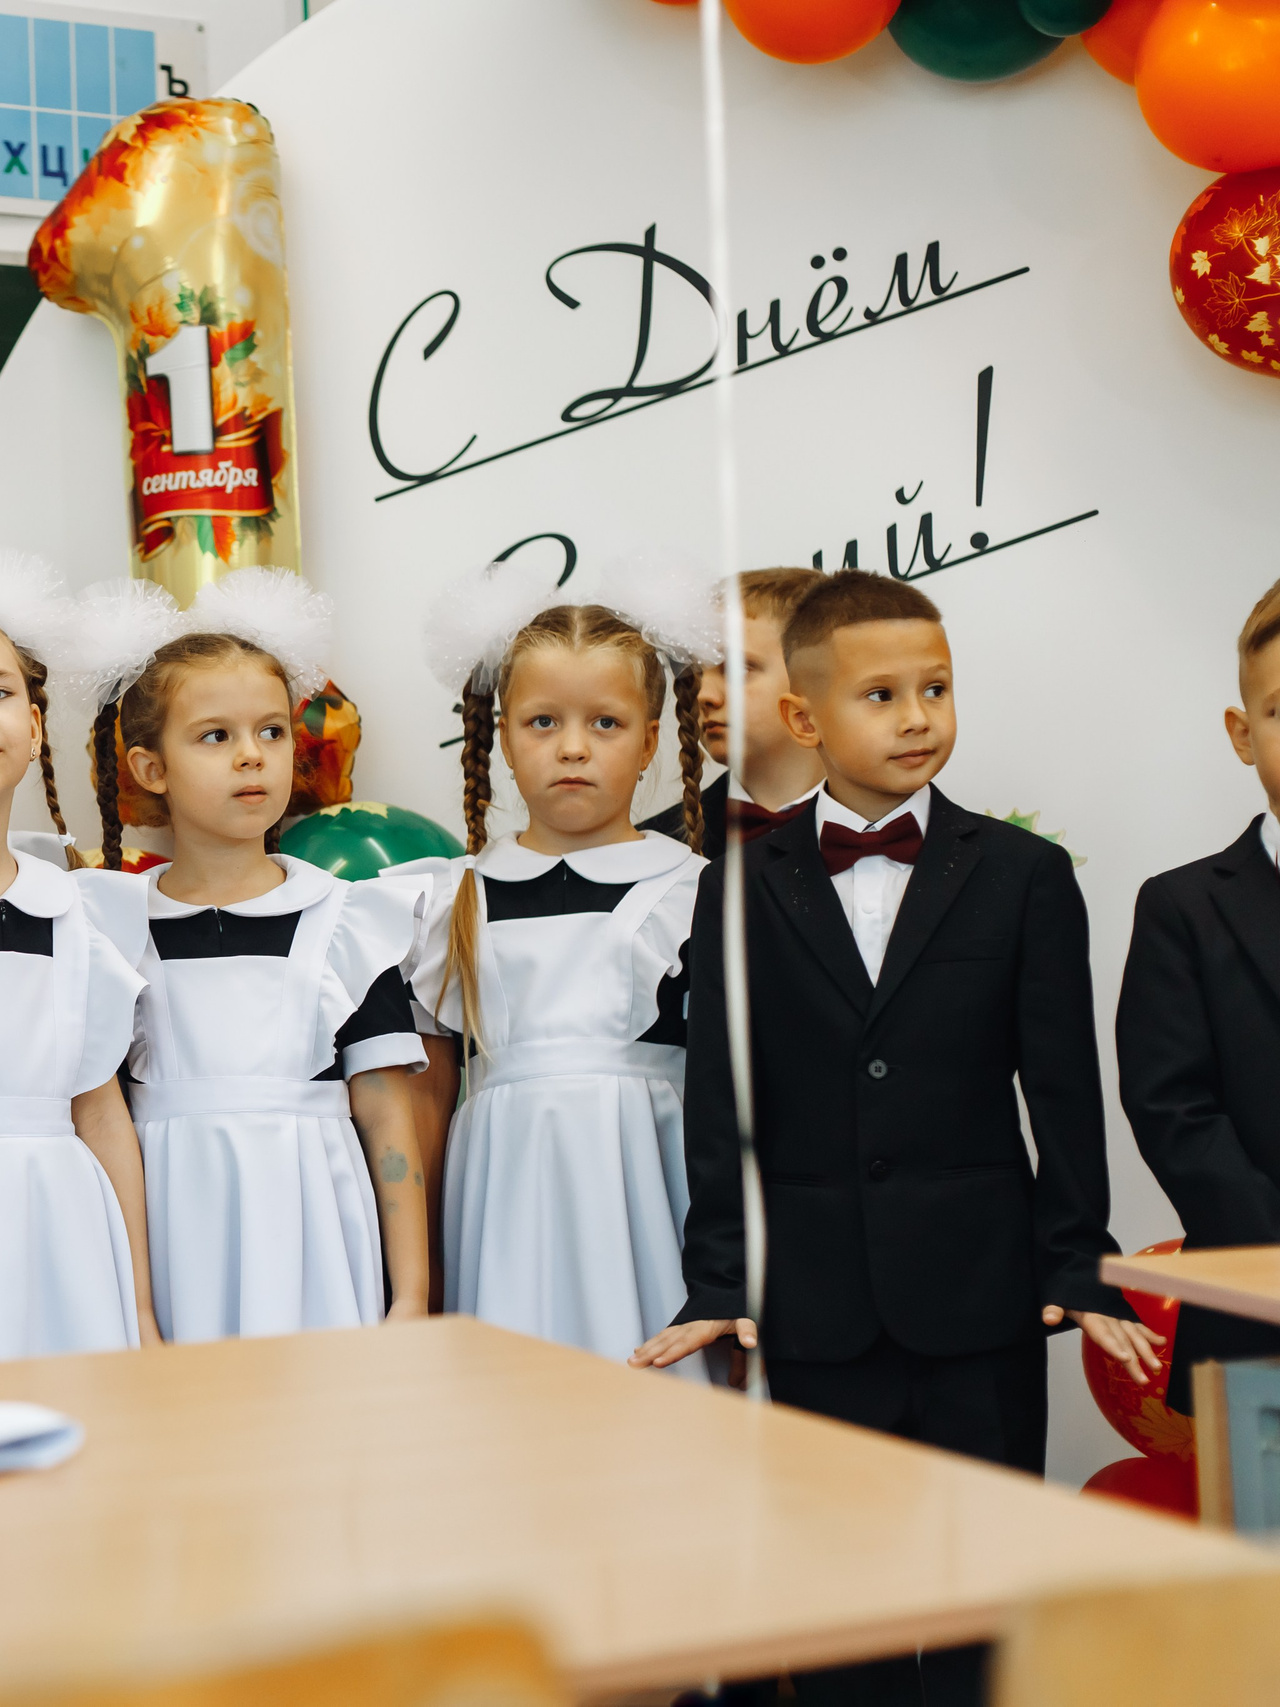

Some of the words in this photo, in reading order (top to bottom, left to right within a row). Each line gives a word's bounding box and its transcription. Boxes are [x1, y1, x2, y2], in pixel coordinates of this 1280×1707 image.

[3, 140, 29, 176] х
[40, 145, 68, 187] ц
[145, 325, 214, 455] 1
[369, 290, 477, 481] С
[545, 222, 959, 423] Днём
[142, 461, 259, 497] сентября
